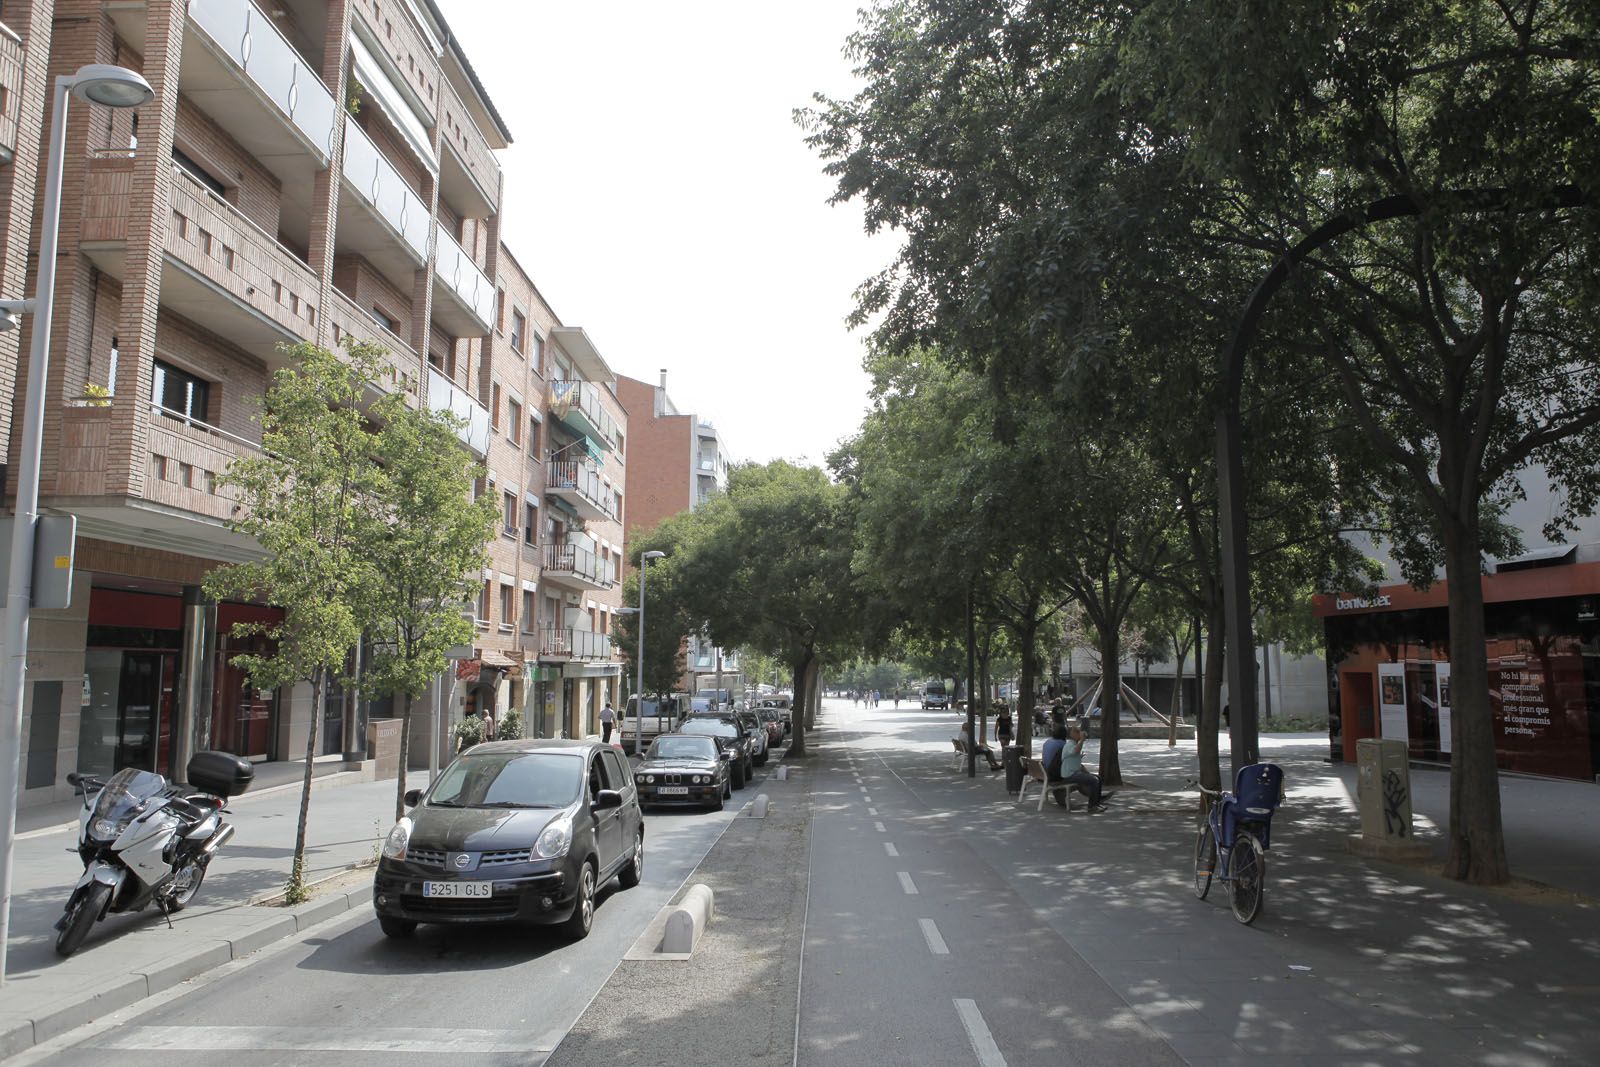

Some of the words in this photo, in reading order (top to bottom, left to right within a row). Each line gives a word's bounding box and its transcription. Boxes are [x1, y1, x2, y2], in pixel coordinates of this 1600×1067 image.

[1501, 672, 1510, 680] No
[1502, 684, 1539, 692] compromis
[1503, 694, 1543, 702] professional
[1519, 706, 1535, 714] gran
[1536, 706, 1549, 715] que
[1512, 716, 1550, 725] compromis
[431, 884, 458, 896] 5251
[465, 884, 489, 896] GLS
